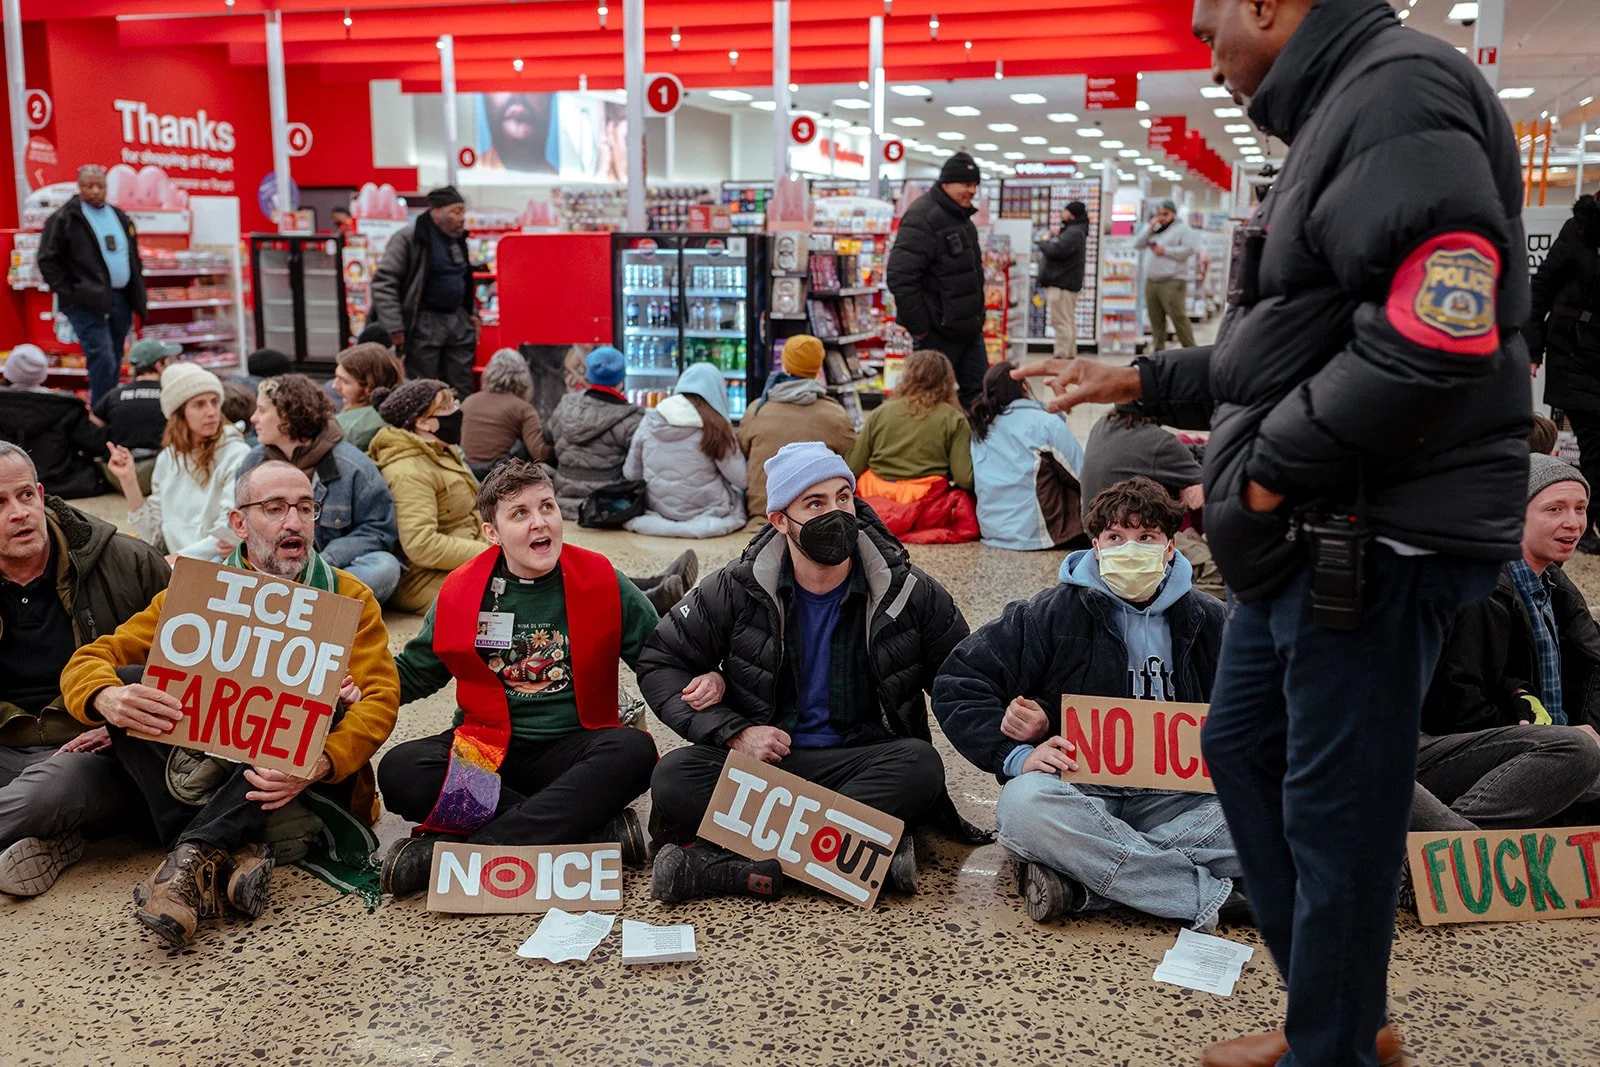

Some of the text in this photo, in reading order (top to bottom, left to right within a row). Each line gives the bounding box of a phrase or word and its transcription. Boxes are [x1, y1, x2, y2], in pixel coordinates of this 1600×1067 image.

[32, 100, 43, 118] 2
[657, 85, 669, 105] 1
[113, 98, 236, 152] Thanks
[797, 122, 810, 138] 3
[140, 149, 189, 170] shopping
[202, 153, 235, 173] Target
[888, 143, 900, 159] 5
[1527, 232, 1551, 268] Ba
[1429, 265, 1494, 298] POLICE
[135, 388, 161, 399] PRESS
[207, 570, 319, 632] ICE
[477, 640, 509, 648] CHAPLAIN
[146, 665, 333, 767] TARGET
[1066, 706, 1135, 776] NO
[712, 767, 893, 889] ICE OUT.
[535, 849, 621, 901] ICE
[1421, 833, 1568, 915] FUCK
